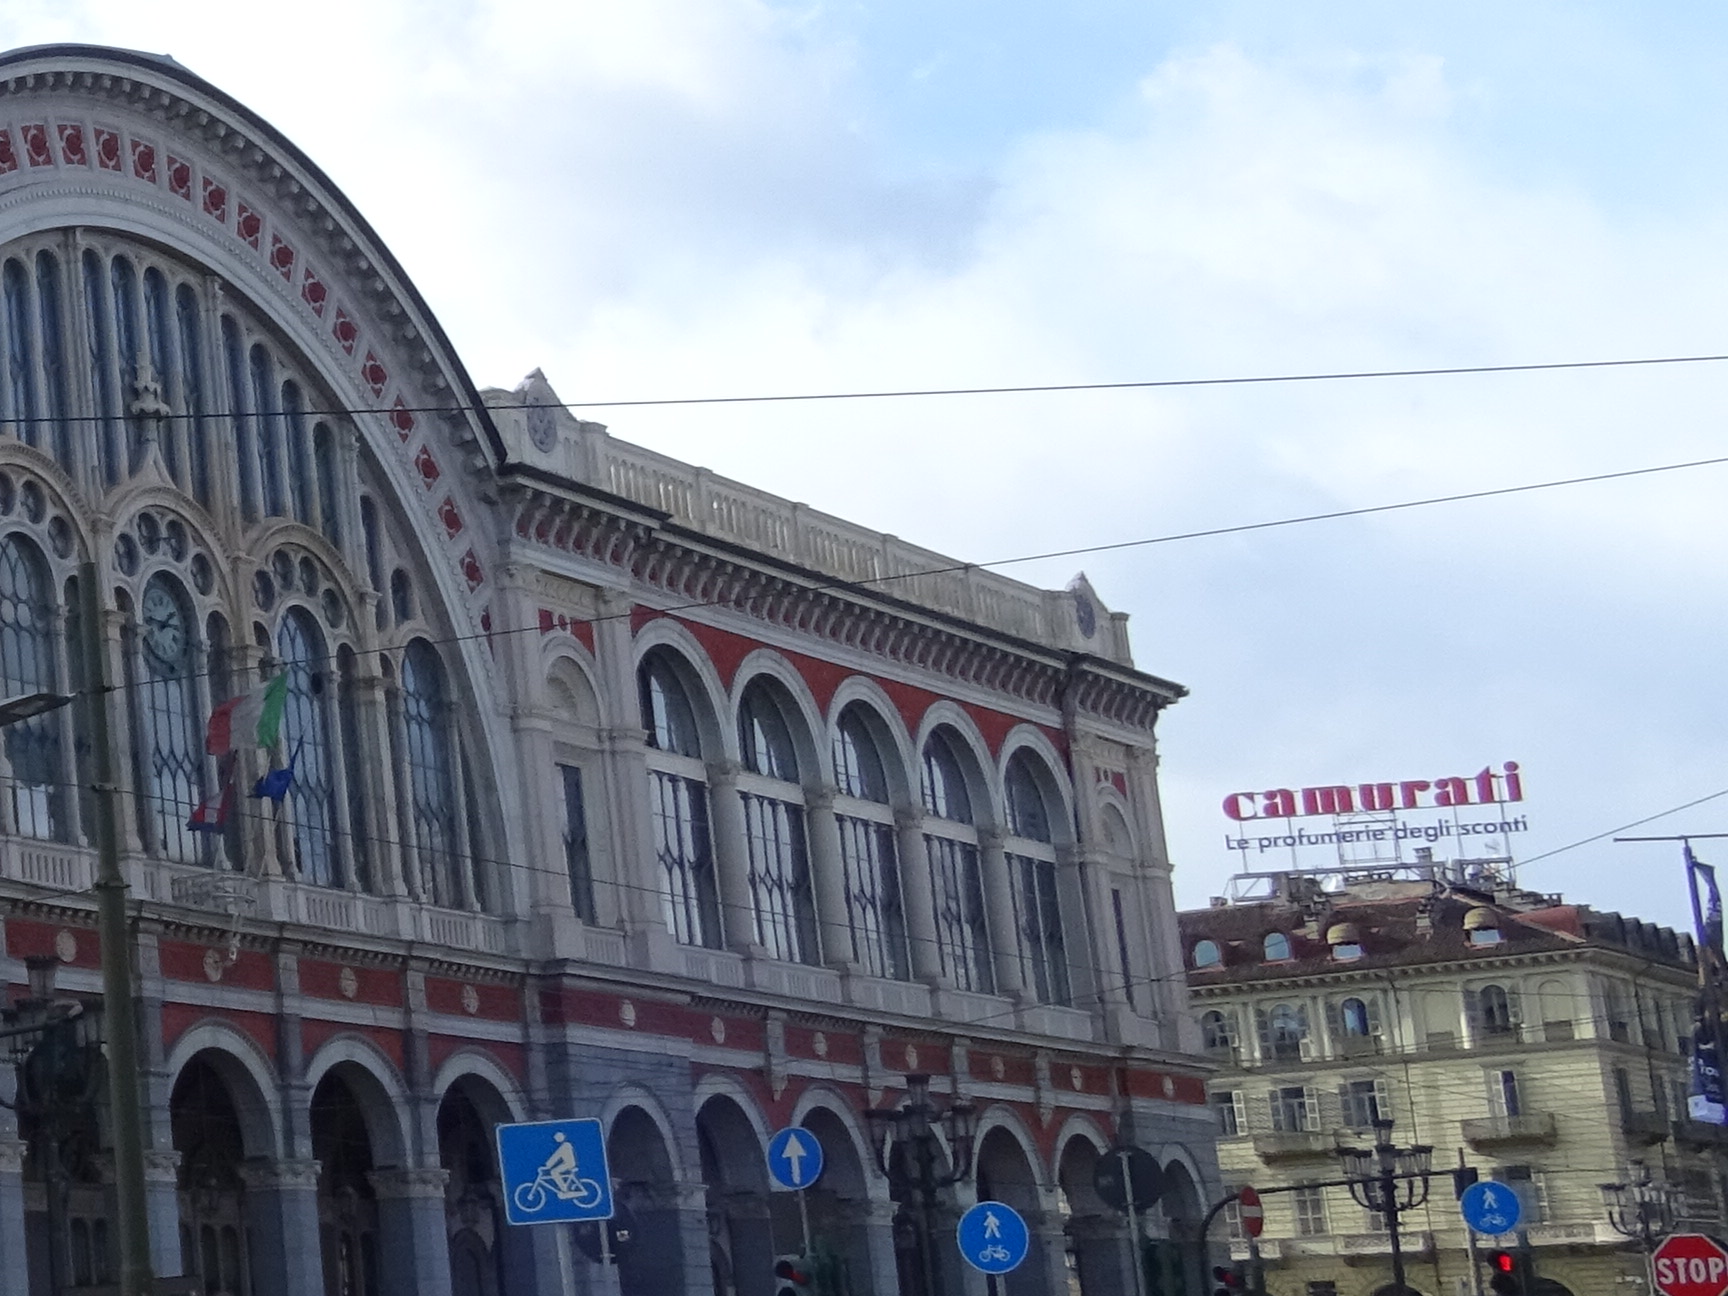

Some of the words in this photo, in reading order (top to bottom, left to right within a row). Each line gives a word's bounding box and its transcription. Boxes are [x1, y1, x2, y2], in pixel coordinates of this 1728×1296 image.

[1223, 761, 1524, 822] camurati
[1225, 833, 1250, 851] Le
[1258, 827, 1386, 853] profumerie
[1394, 818, 1451, 844] degli
[1460, 815, 1529, 836] sconti
[1657, 1257, 1725, 1285] STOP
